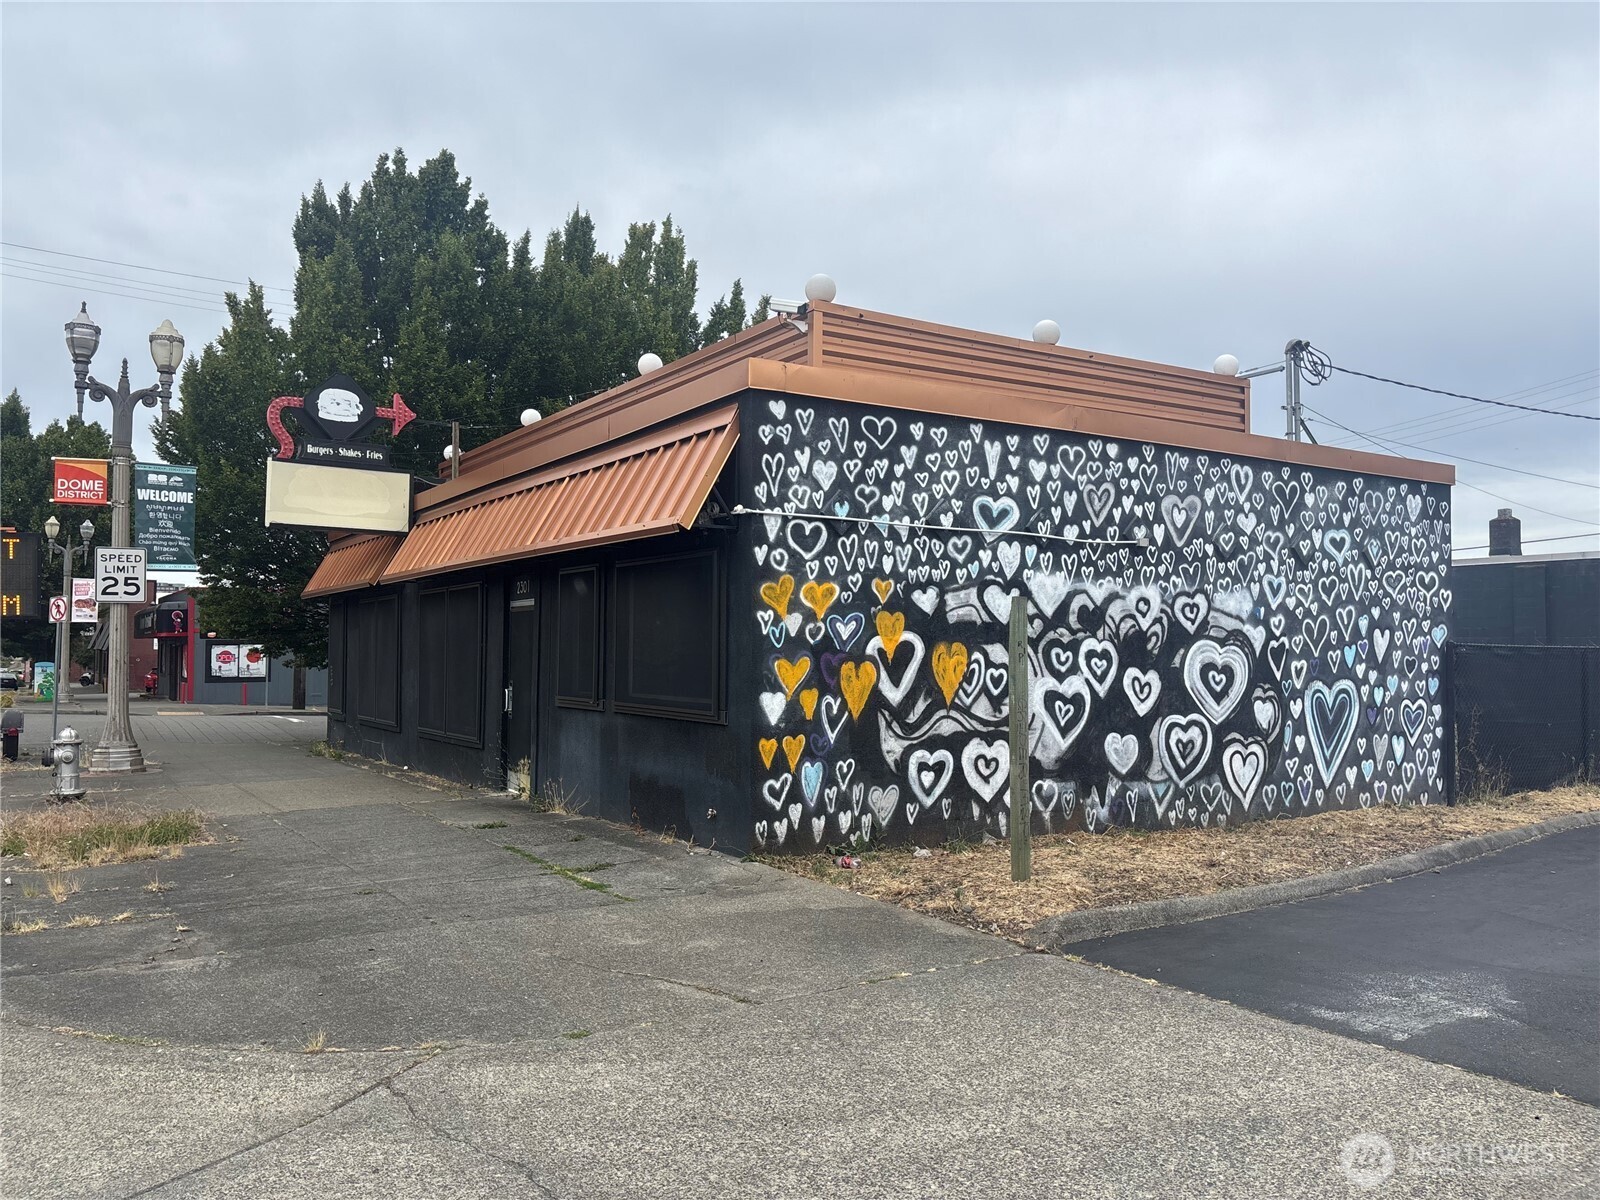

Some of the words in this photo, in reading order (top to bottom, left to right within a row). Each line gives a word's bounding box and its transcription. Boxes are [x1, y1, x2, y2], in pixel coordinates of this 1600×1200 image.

[307, 444, 334, 456] Burgers
[366, 450, 384, 460] Fries
[57, 478, 104, 491] DOME
[57, 490, 104, 499] DISTRICT
[137, 488, 194, 504] WELCOME
[149, 527, 182, 535] Bienvenido
[100, 553, 143, 563] SPEED
[104, 565, 138, 574] LIMIT
[100, 576, 141, 596] 25
[516, 580, 530, 594] 2301
